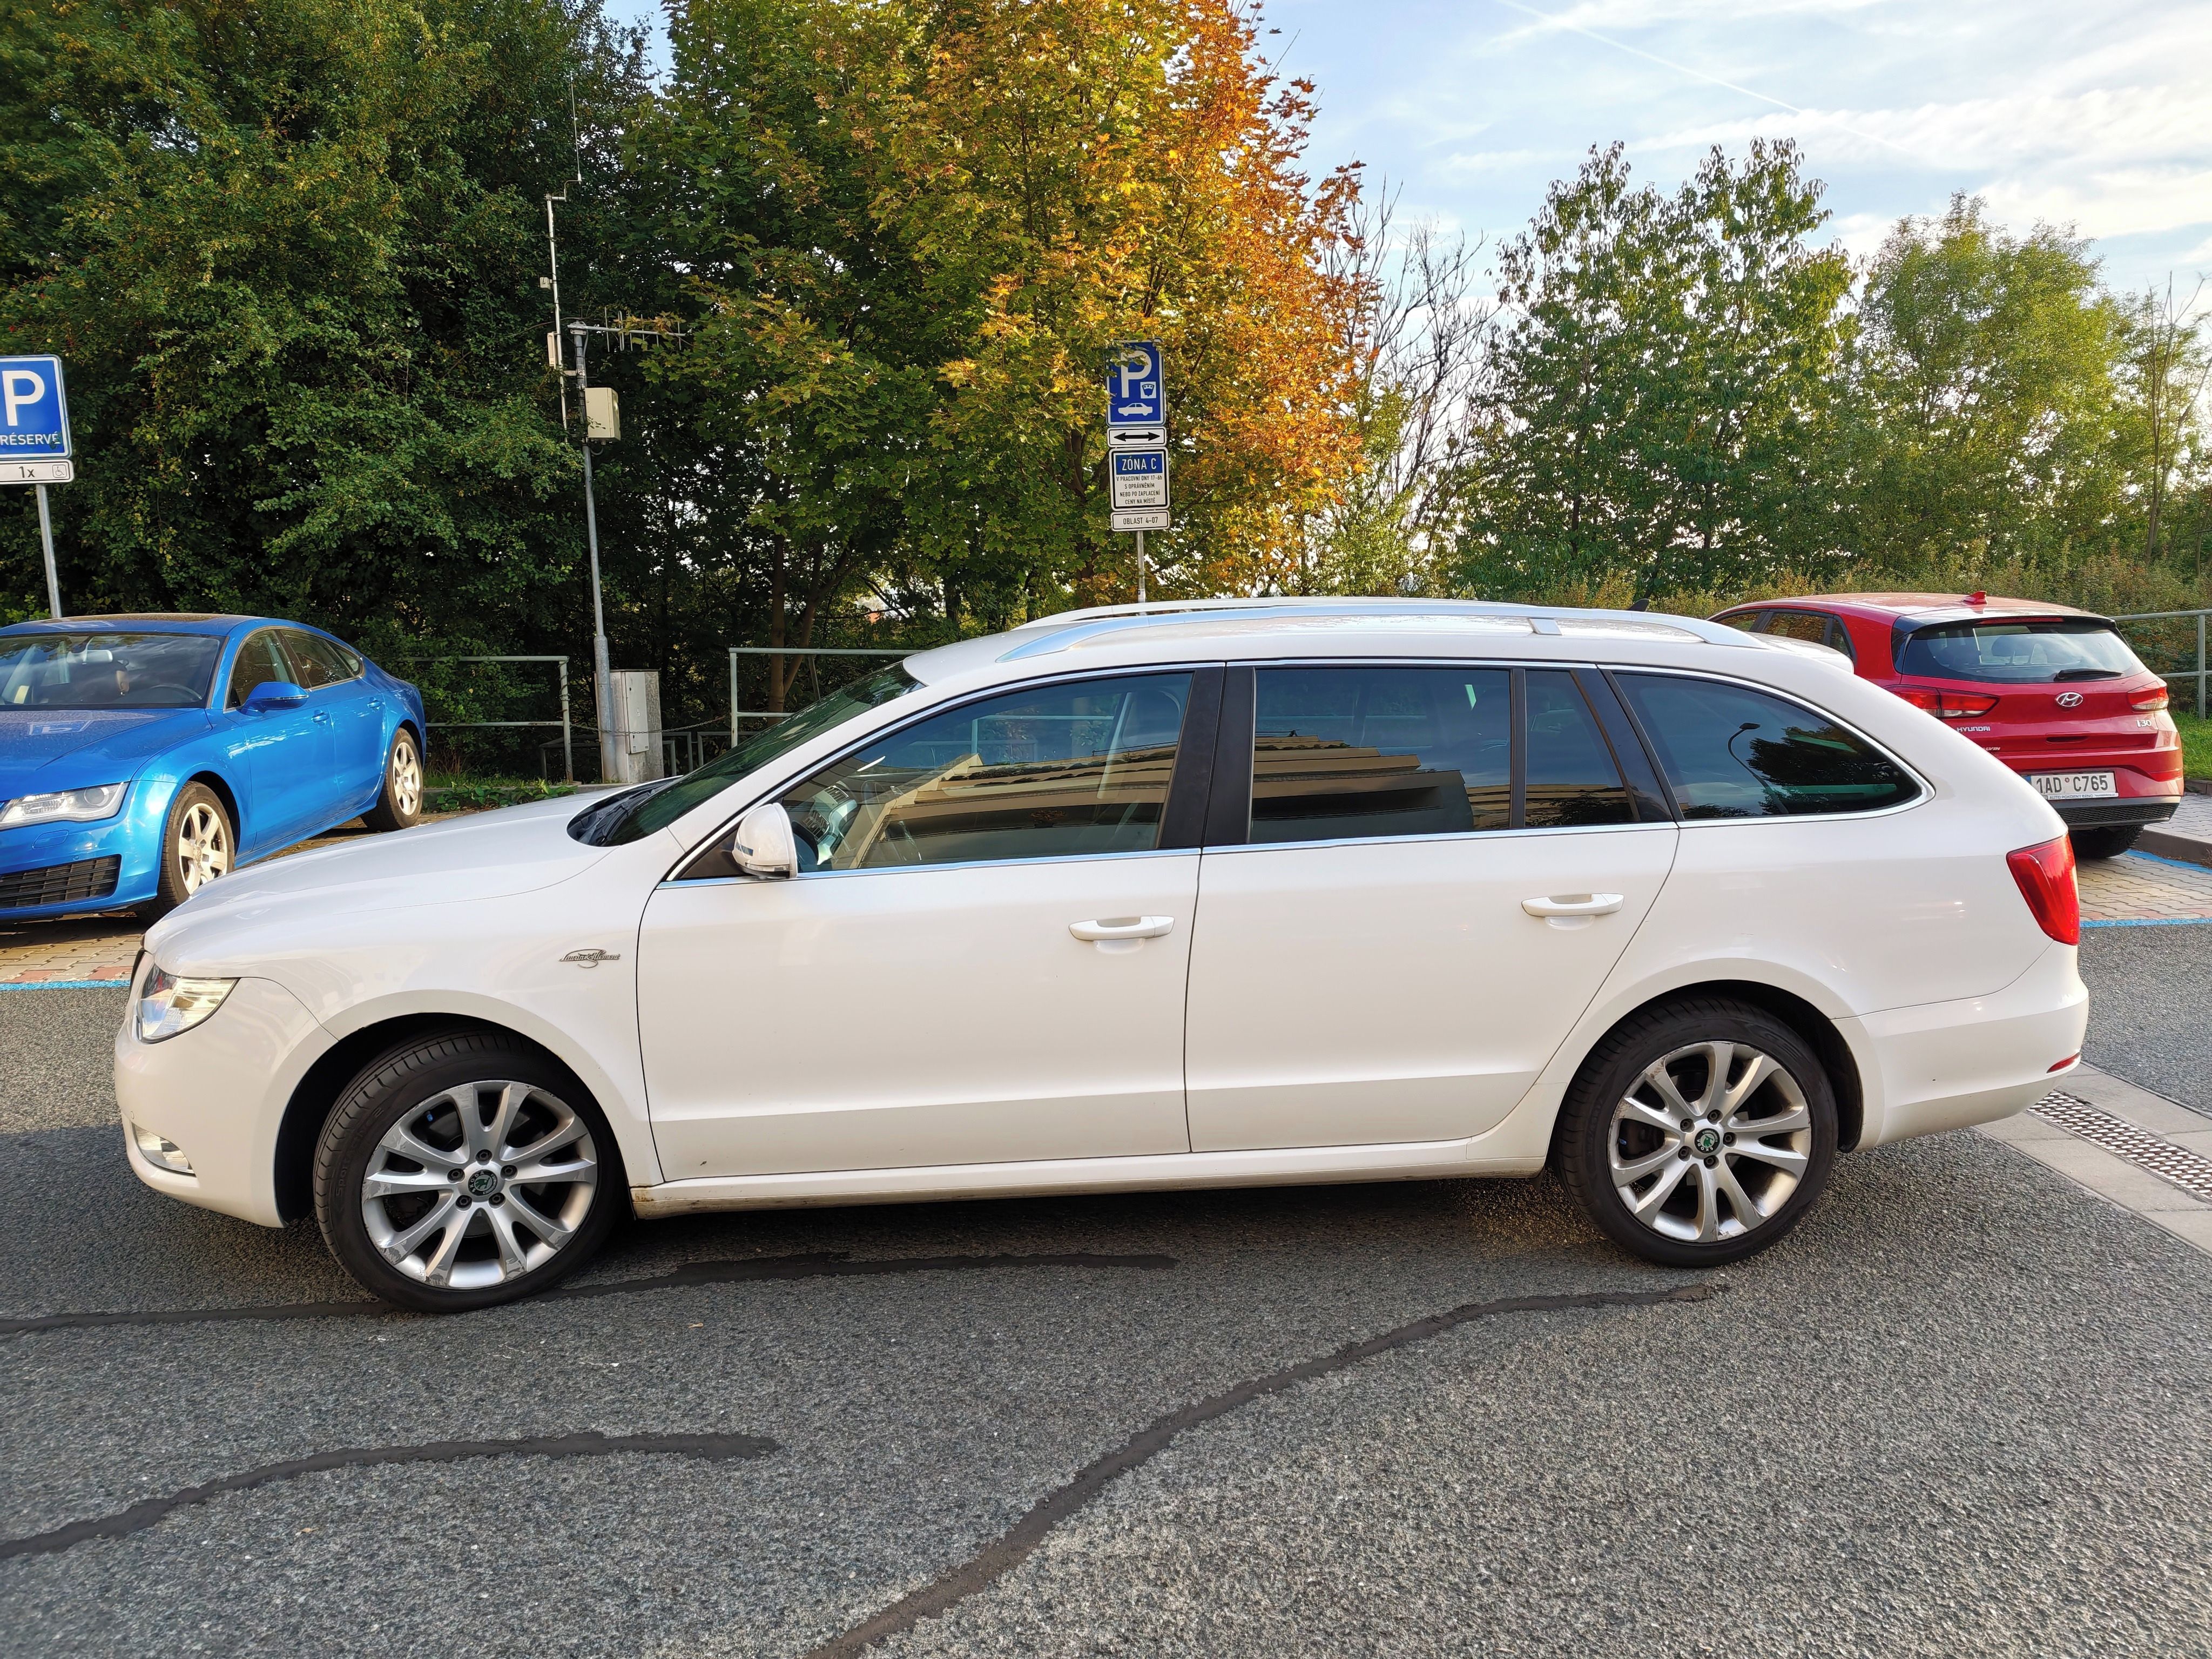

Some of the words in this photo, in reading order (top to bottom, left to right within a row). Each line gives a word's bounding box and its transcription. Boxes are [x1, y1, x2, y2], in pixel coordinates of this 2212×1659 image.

[1120, 350, 1152, 398] P
[2, 370, 45, 426] P
[1122, 455, 1147, 471] ZÓNA
[1151, 457, 1157, 470] C
[18, 466, 35, 478] 1x
[1123, 517, 1143, 525] OBLAST
[2036, 777, 2062, 793] 1AD
[2073, 774, 2108, 792] C765
